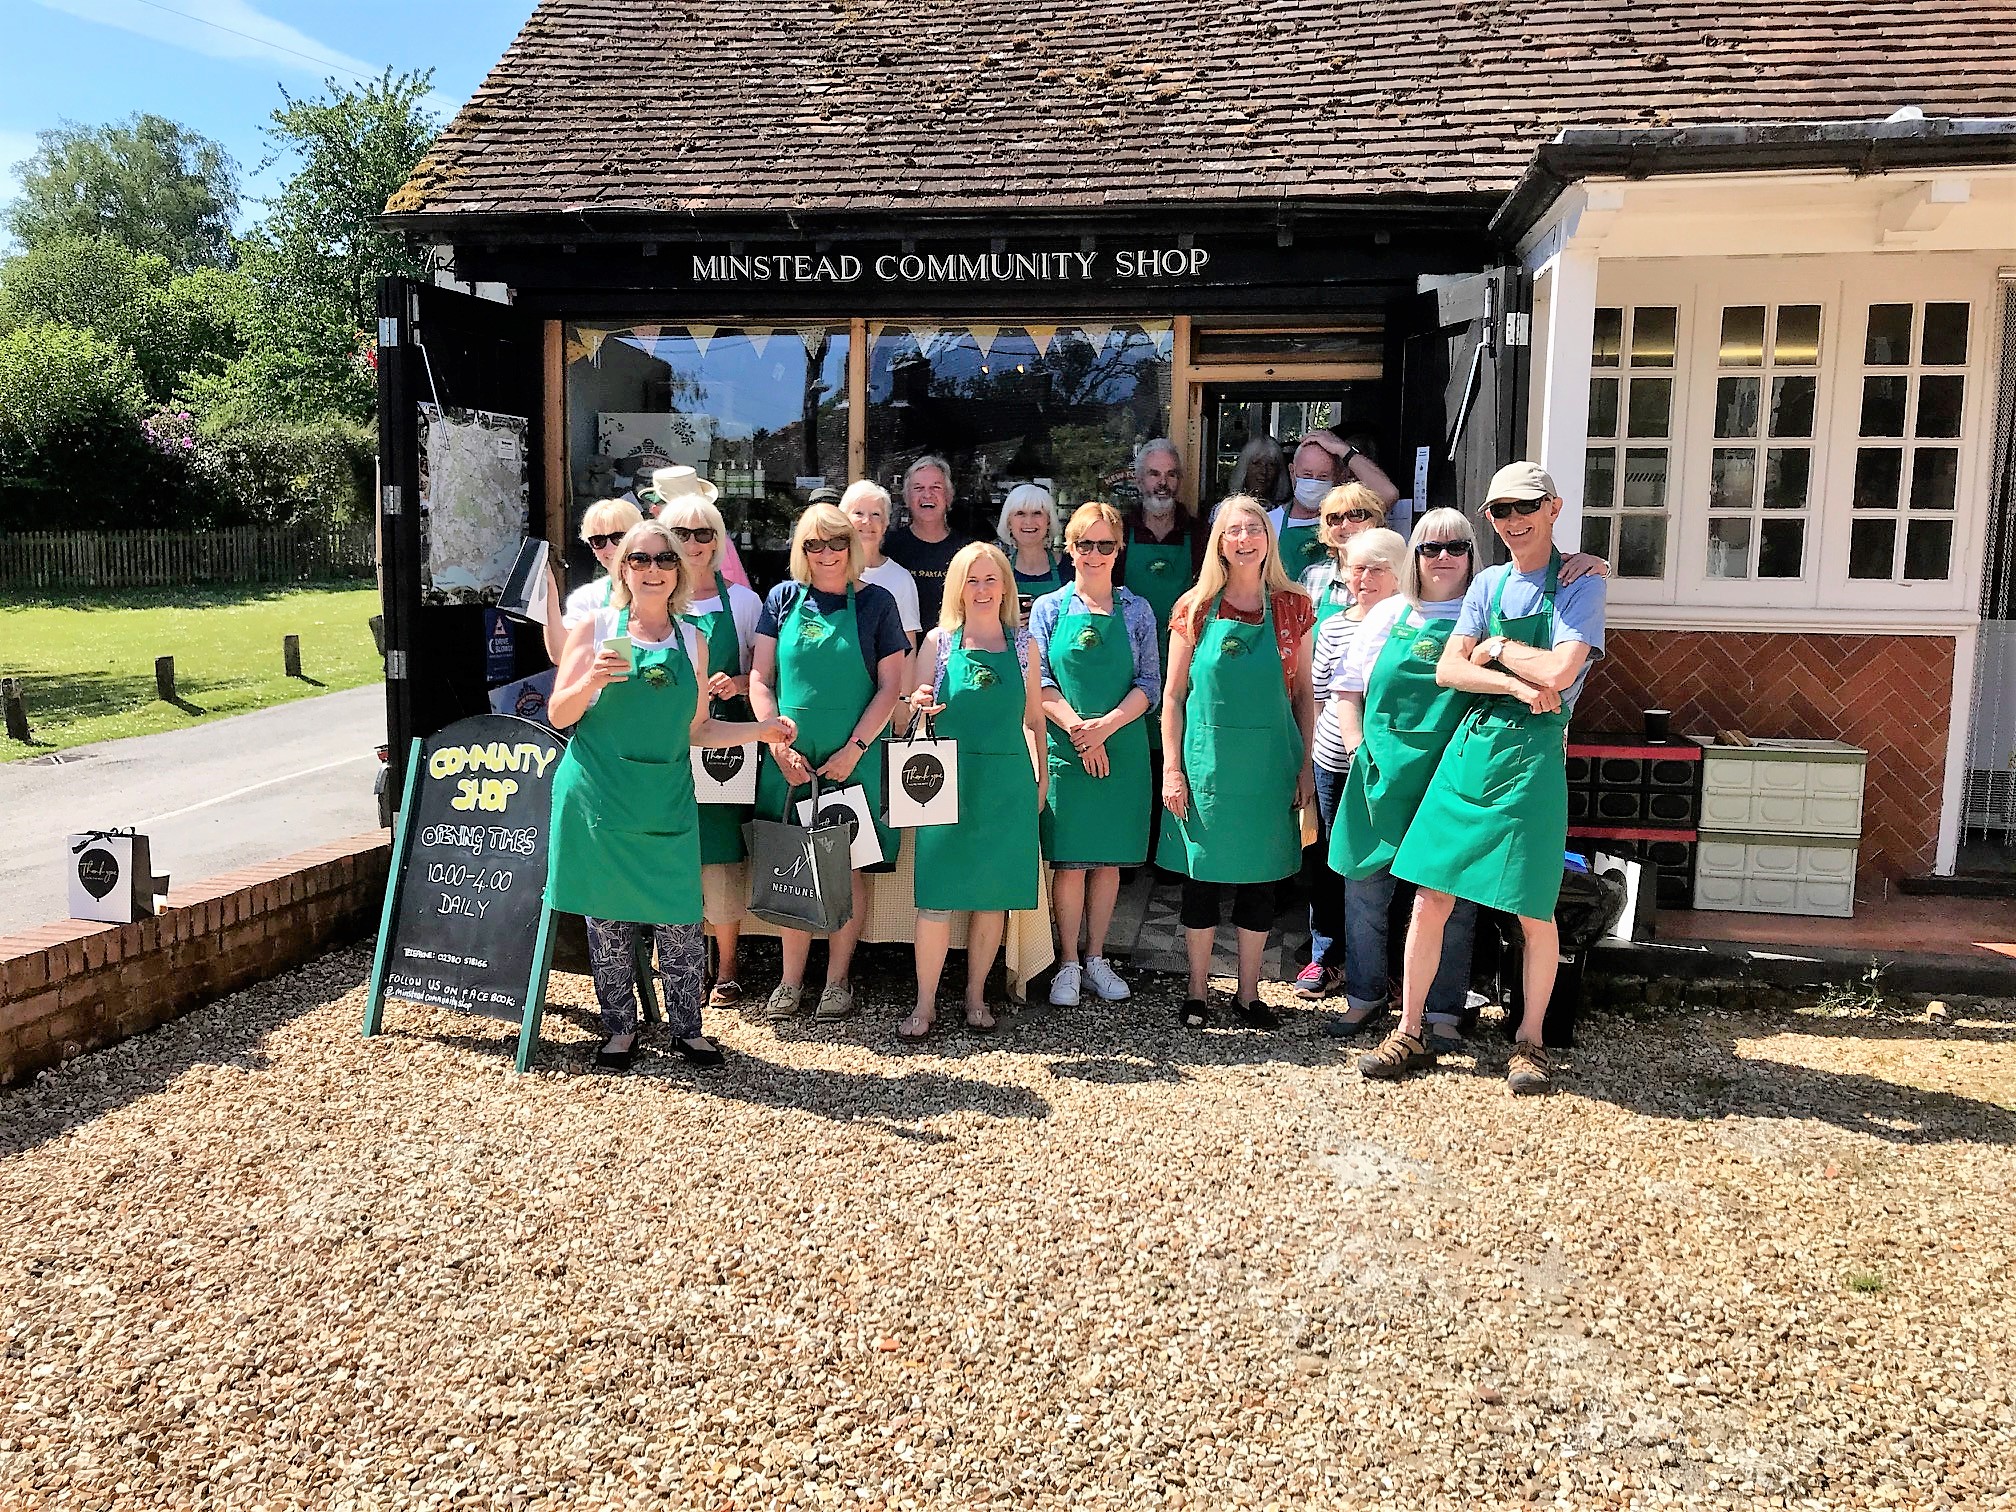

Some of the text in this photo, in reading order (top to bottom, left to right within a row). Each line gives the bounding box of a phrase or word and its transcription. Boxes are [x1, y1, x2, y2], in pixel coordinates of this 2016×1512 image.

[692, 248, 1210, 282] MINSTEAD COMMUNITY SHOP
[902, 765, 930, 784] Thank
[451, 778, 519, 812] SHOP
[487, 826, 538, 855] TIMES
[772, 882, 814, 898] NEPTUNE
[438, 893, 490, 919] DAILY
[388, 973, 422, 986] FOLLOW
[427, 979, 441, 991] US
[443, 985, 459, 996] ON
